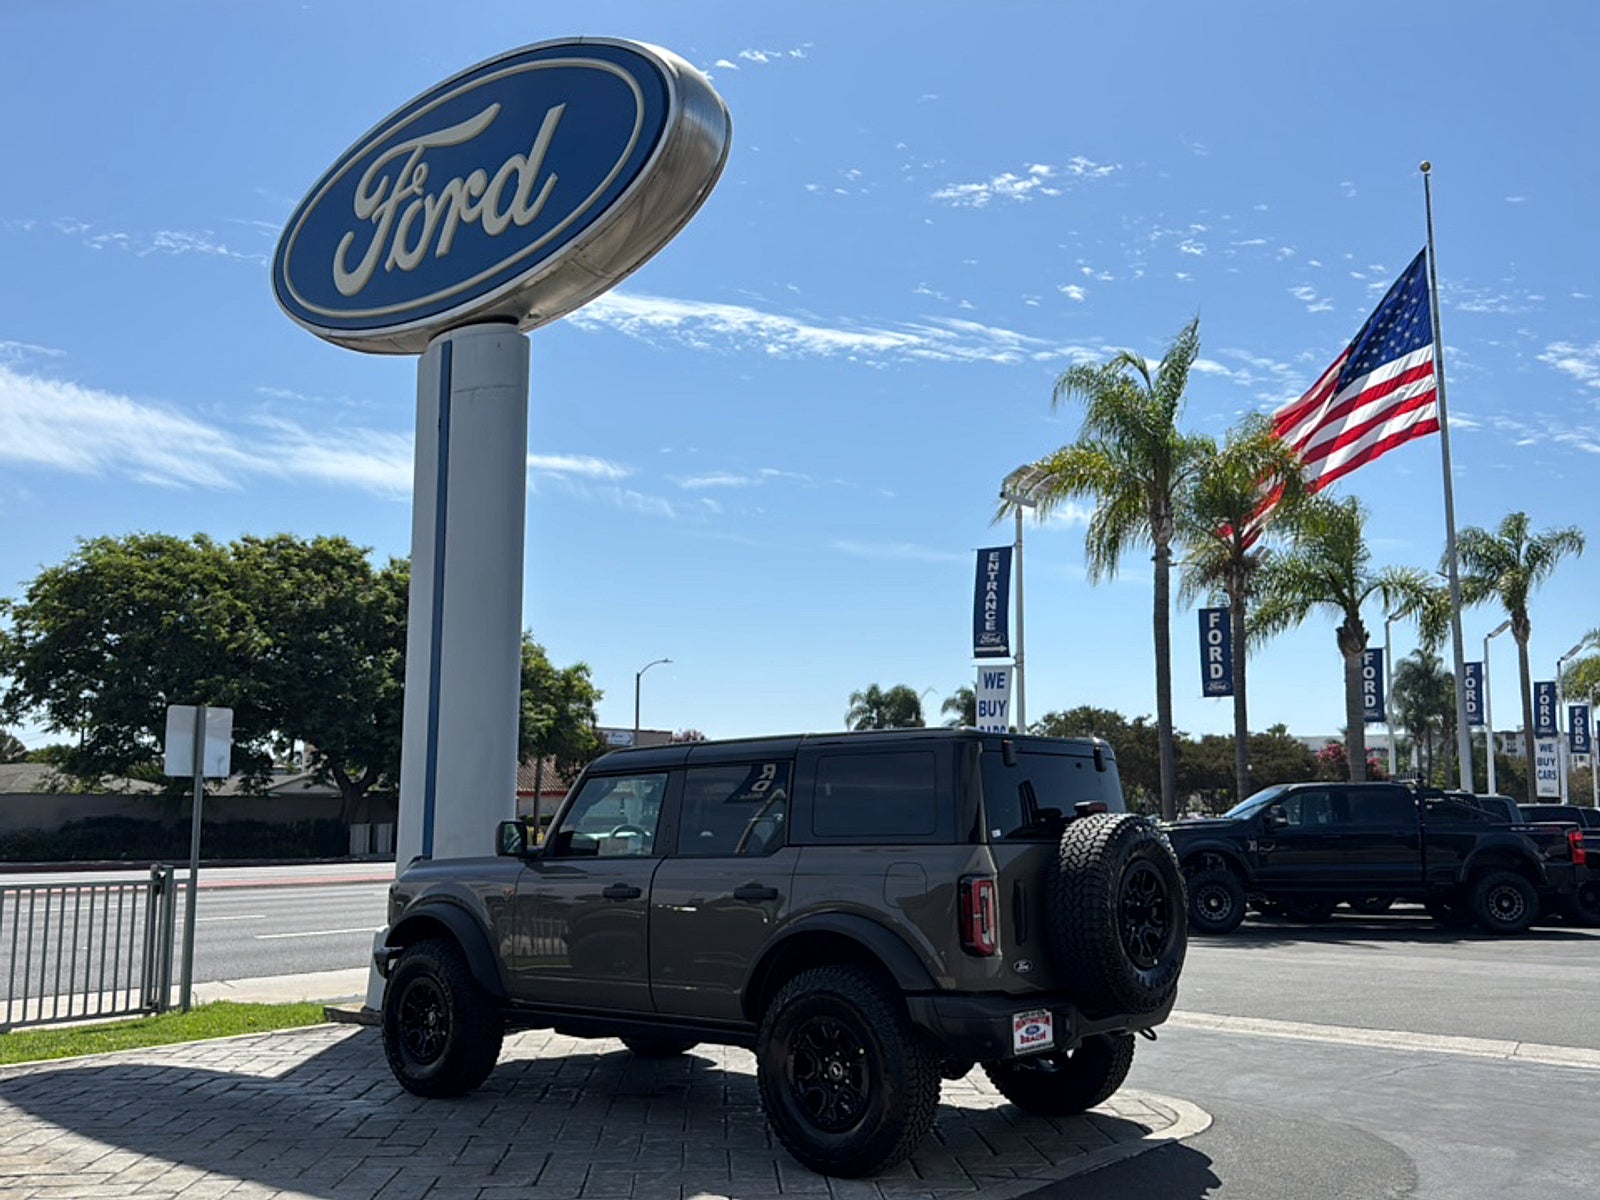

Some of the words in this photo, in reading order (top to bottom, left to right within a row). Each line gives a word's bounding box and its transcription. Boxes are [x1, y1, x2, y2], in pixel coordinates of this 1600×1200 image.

[333, 103, 565, 295] Ford
[985, 552, 999, 630] ENTRANCE
[1207, 612, 1223, 679] FORD
[984, 672, 1005, 689] WE
[1363, 652, 1376, 708] FORD
[1465, 665, 1476, 713] FORD
[979, 700, 1007, 717] BUY
[1539, 684, 1550, 726] FORD
[1574, 708, 1584, 744] FORD
[1537, 757, 1556, 766] BUY
[1540, 743, 1553, 753] WE
[1537, 769, 1557, 781] CARS
